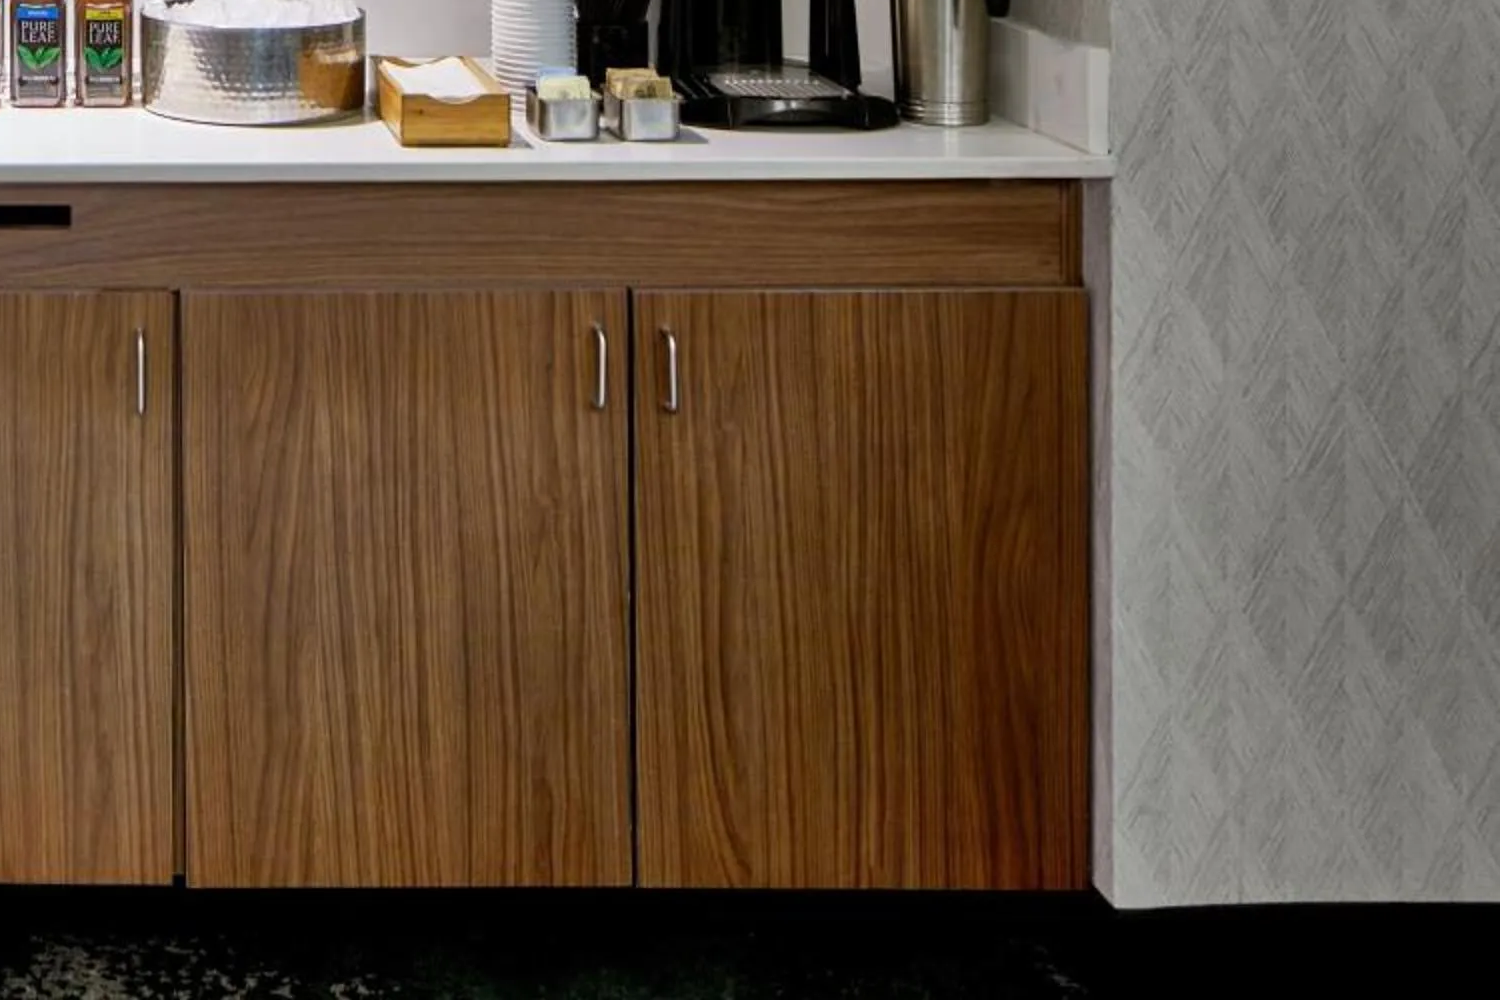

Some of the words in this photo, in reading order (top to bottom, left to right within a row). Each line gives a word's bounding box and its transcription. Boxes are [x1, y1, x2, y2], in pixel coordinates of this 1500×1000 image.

[21, 21, 56, 32] PURE
[89, 21, 120, 33] PURE
[21, 32, 55, 43] LEAF
[89, 33, 119, 44] LEAF
